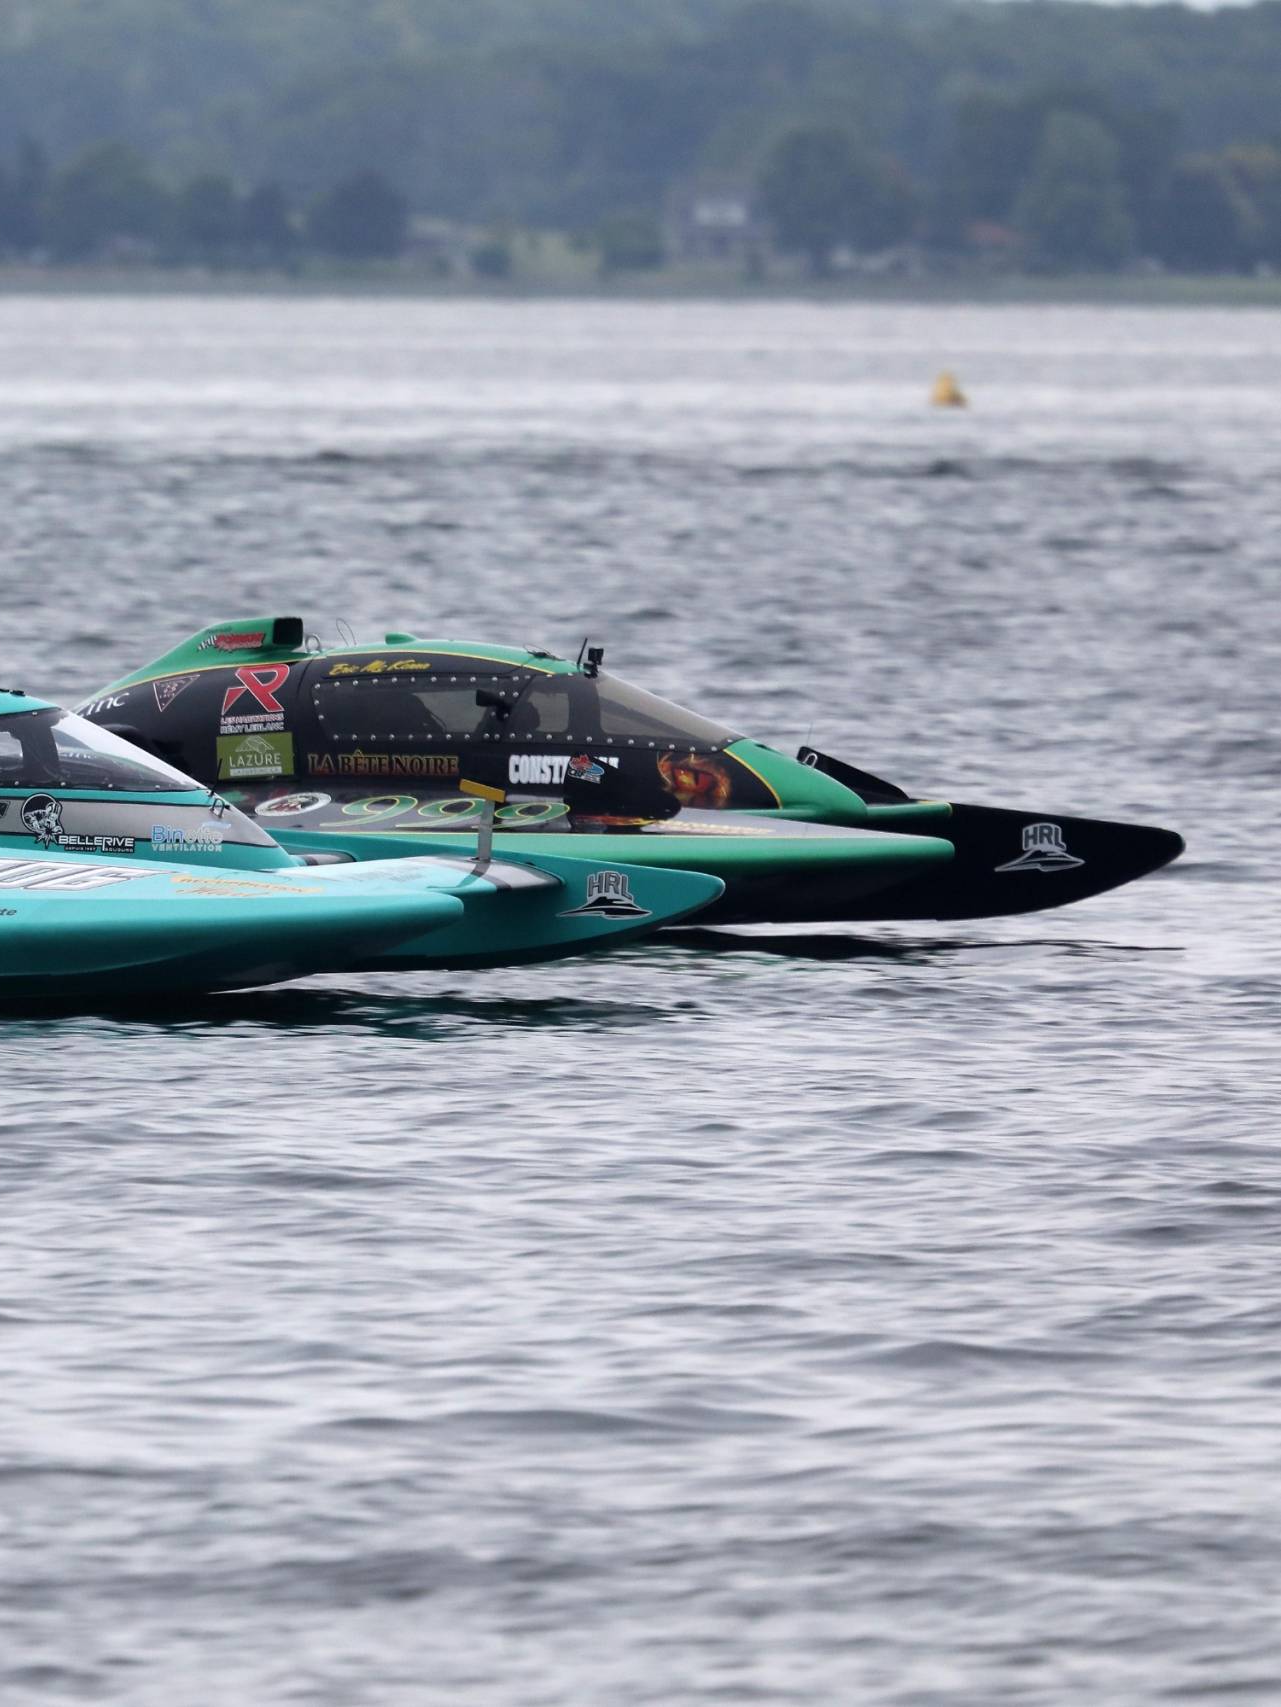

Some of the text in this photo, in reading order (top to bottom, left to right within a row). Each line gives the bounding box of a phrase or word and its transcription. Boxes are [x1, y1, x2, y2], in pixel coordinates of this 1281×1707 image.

[229, 753, 282, 767] LAZURE
[308, 754, 335, 775] LA
[339, 749, 389, 776] BÊTE
[393, 754, 460, 776] NOIRE
[59, 835, 135, 848] BELLERIVE
[1023, 823, 1067, 850] HRL
[152, 843, 222, 852] VENTILATION
[586, 870, 634, 900] HRL
